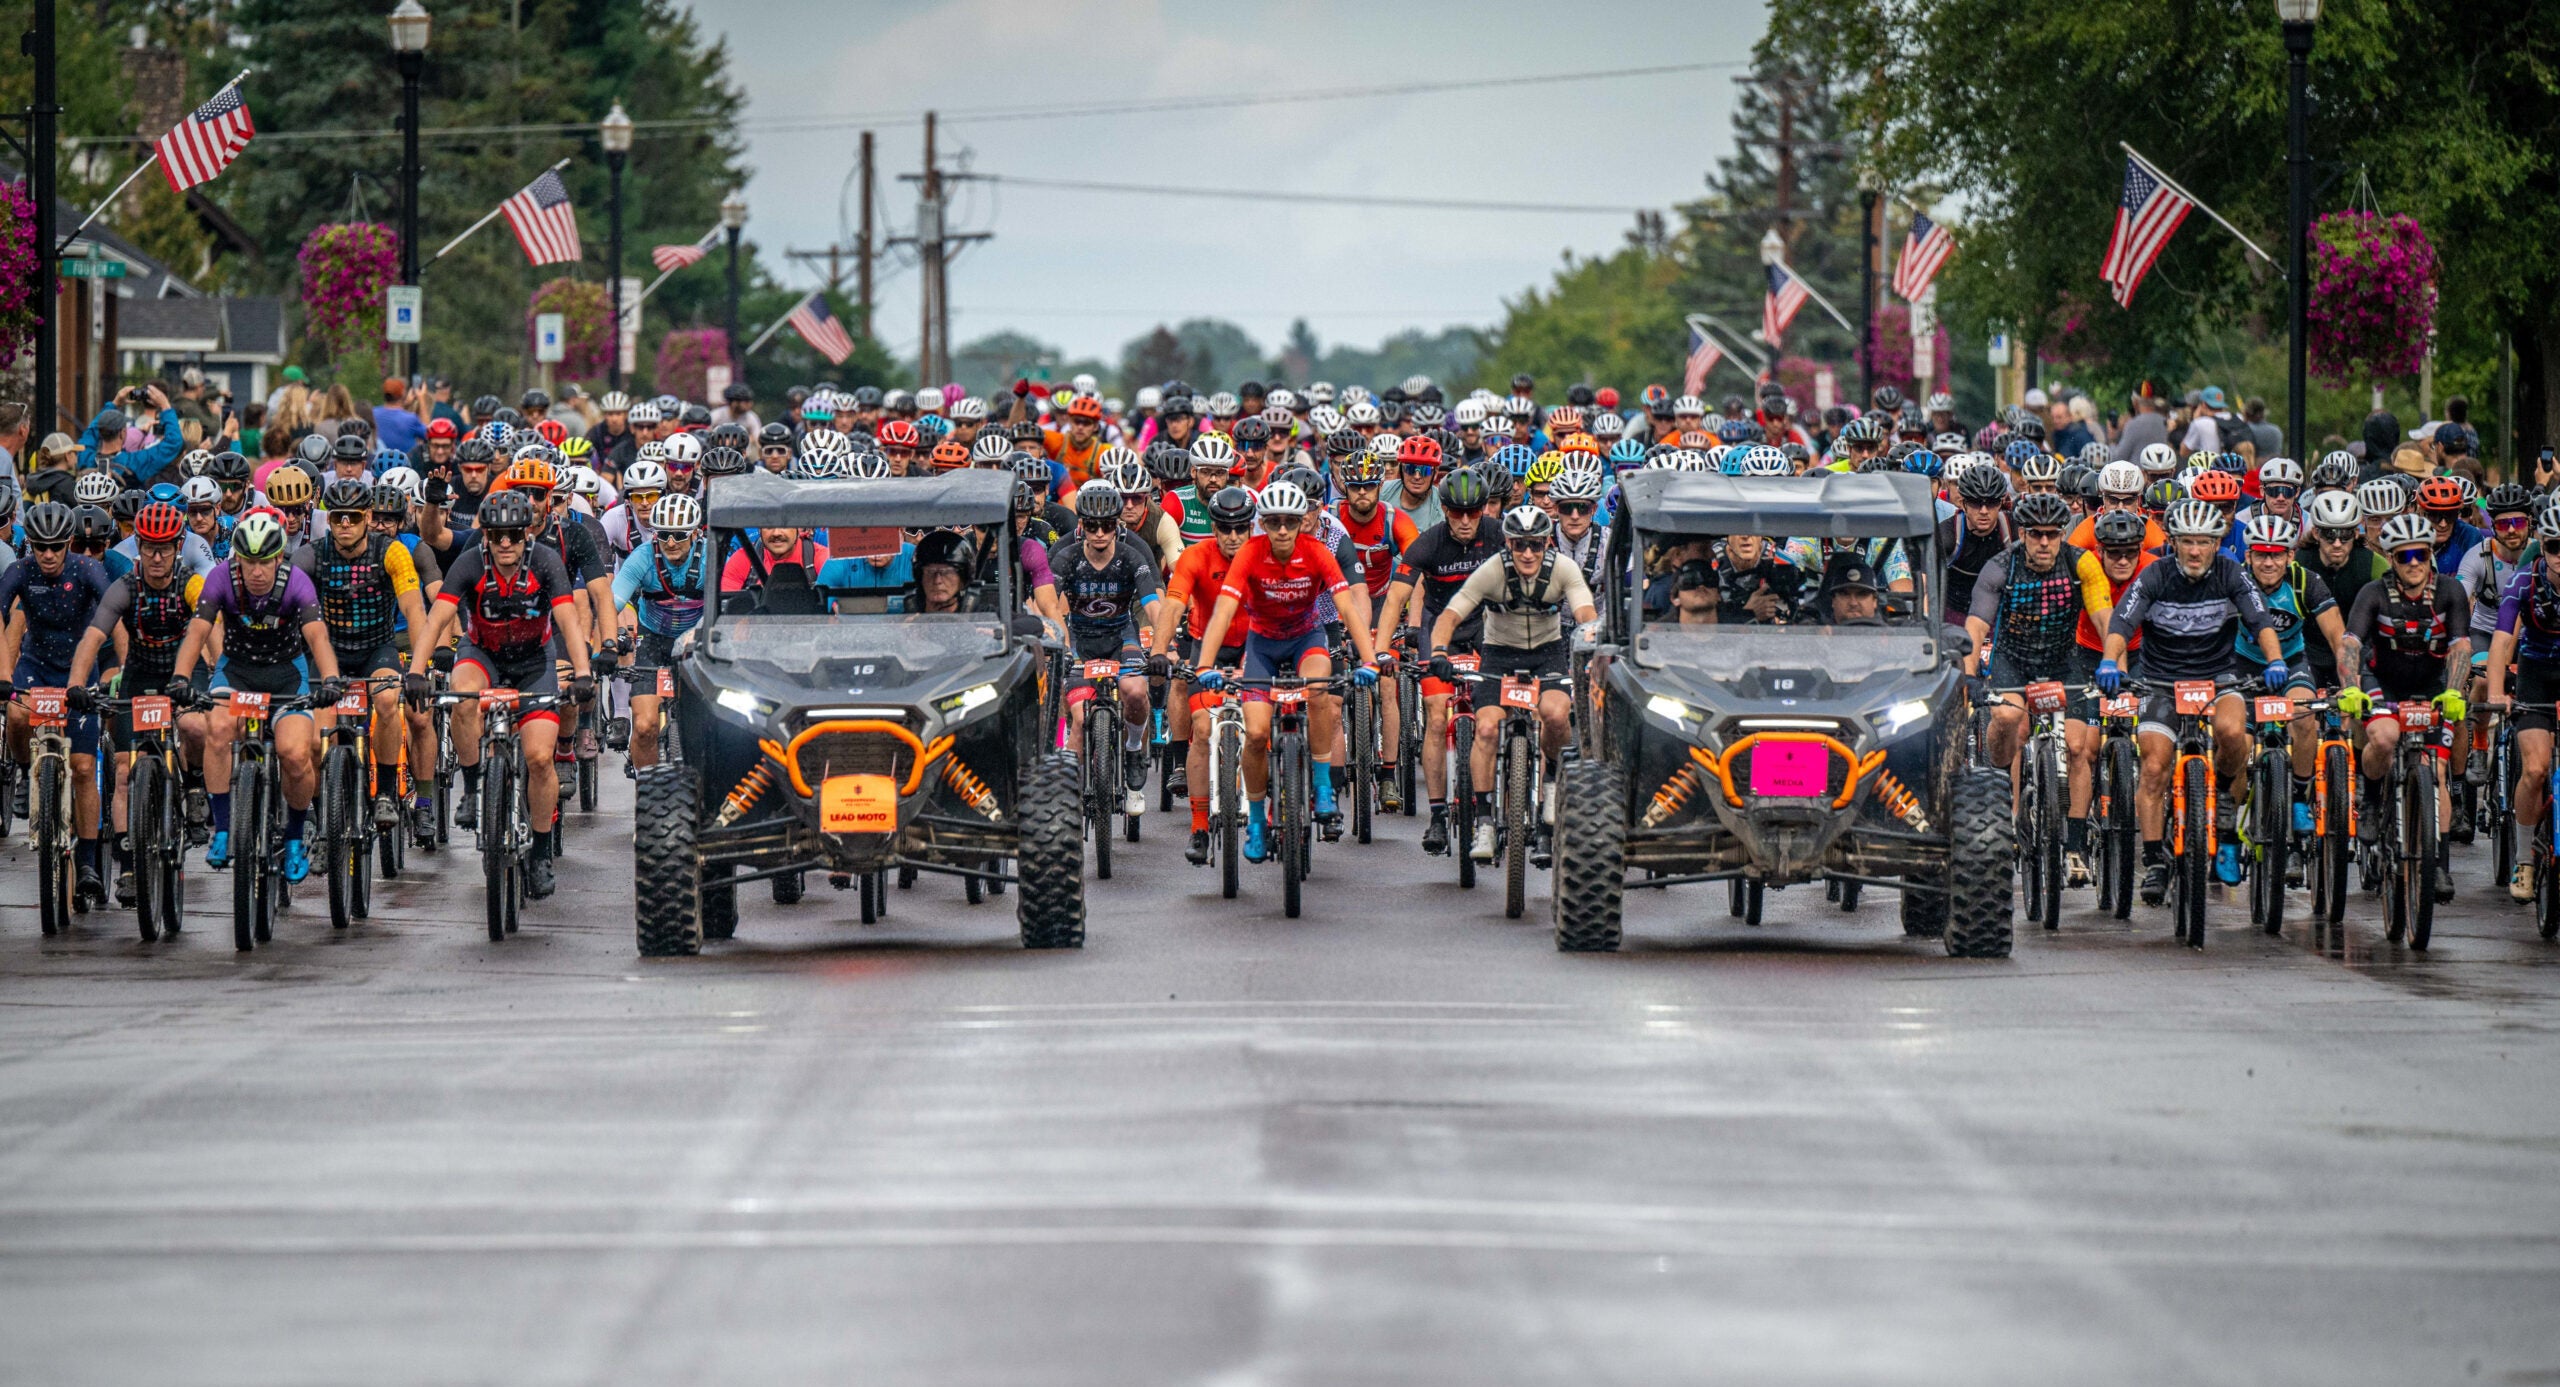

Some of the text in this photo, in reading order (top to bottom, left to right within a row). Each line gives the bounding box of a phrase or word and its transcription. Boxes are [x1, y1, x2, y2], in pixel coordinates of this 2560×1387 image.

[1186, 516, 1207, 525] TRASH
[1079, 582, 1118, 592] SPIN
[853, 664, 875, 675] 16
[1090, 666, 1112, 675] 241
[236, 693, 261, 704] 329
[2182, 691, 2208, 702] 444
[36, 700, 60, 713] 223
[2263, 702, 2286, 715] 879
[141, 709, 162, 723] 417
[2406, 712, 2430, 726] 286
[829, 812, 887, 821] LEAD MOTO
